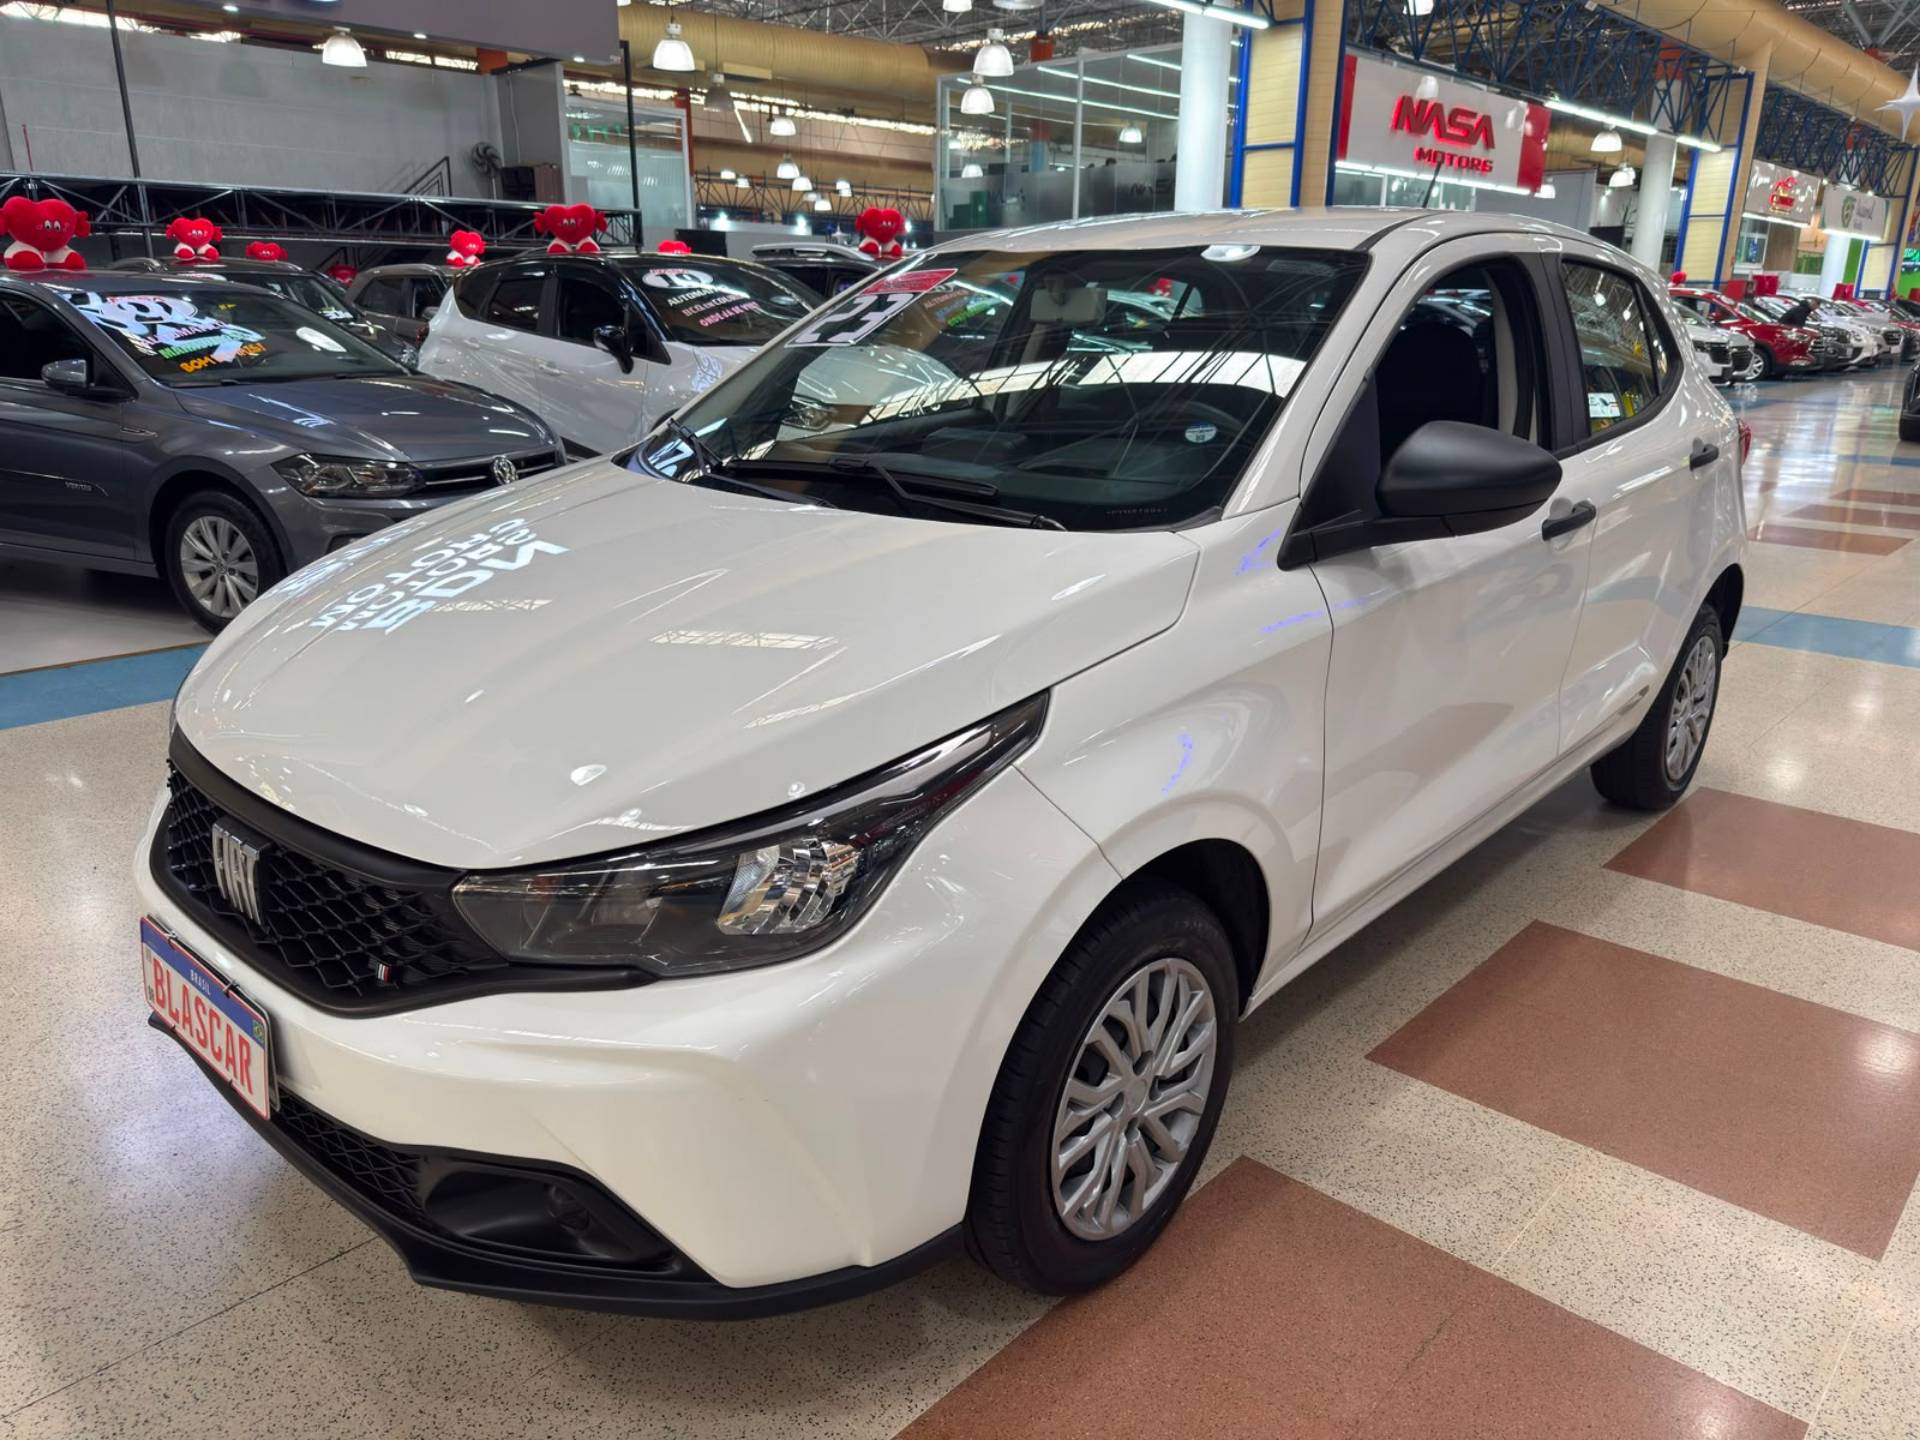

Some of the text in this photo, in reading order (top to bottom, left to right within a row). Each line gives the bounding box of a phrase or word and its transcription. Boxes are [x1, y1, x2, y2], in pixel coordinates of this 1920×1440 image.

[1391, 95, 1495, 150] NASA
[1414, 147, 1493, 173] MOTORS
[795, 293, 914, 344] 23
[190, 968, 211, 996] BRASIL
[153, 958, 254, 1096] BLASCAR
